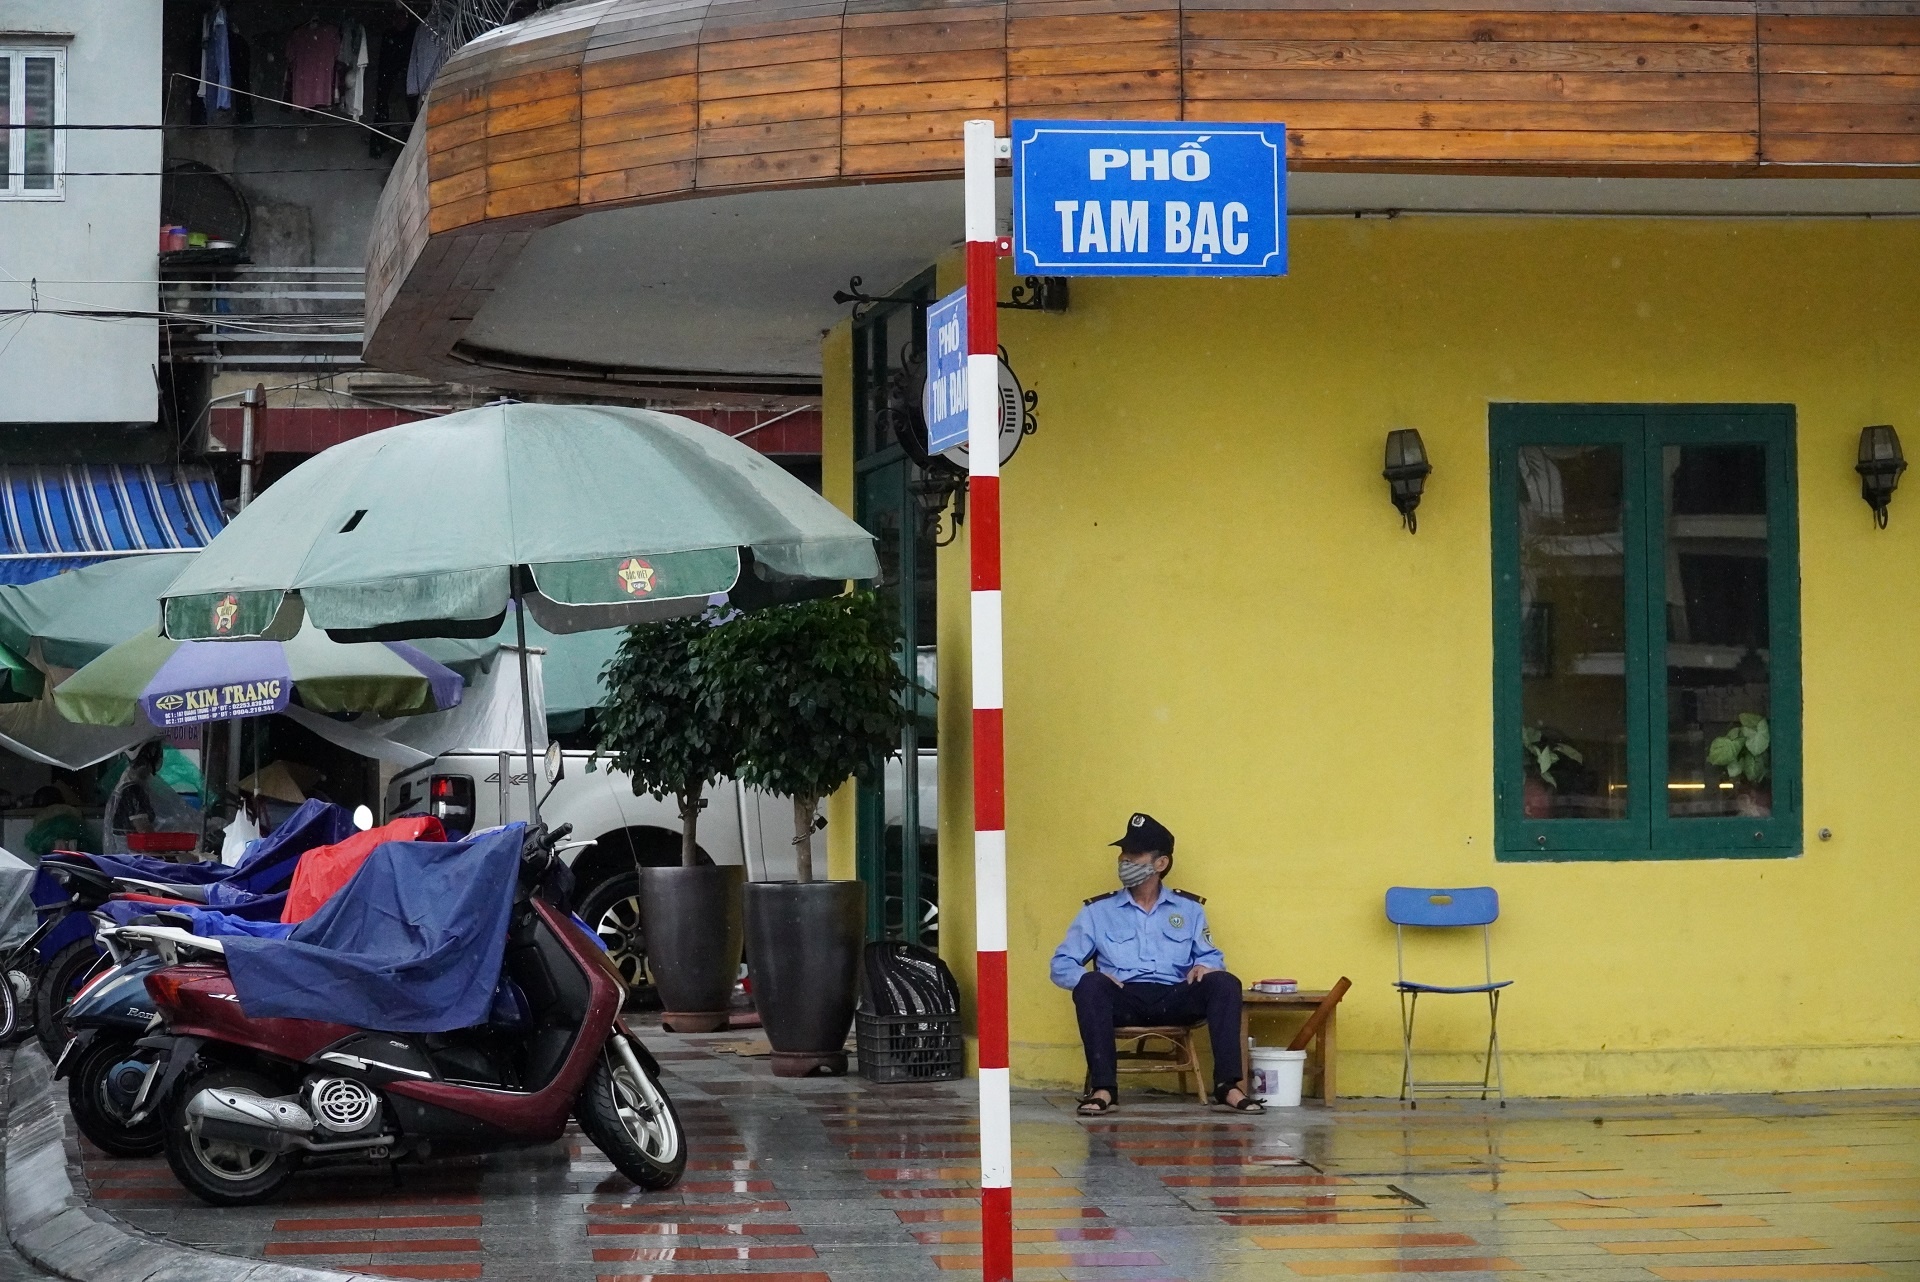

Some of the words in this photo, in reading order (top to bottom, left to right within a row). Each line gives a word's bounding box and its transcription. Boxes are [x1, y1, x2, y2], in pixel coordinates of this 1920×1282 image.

[1089, 136, 1212, 182] PHỐ
[1054, 200, 1149, 253] TAM
[1165, 201, 1249, 262] BẠC
[938, 306, 960, 358] PHỐ
[185, 687, 219, 709] KIM
[222, 679, 281, 705] TRANG
